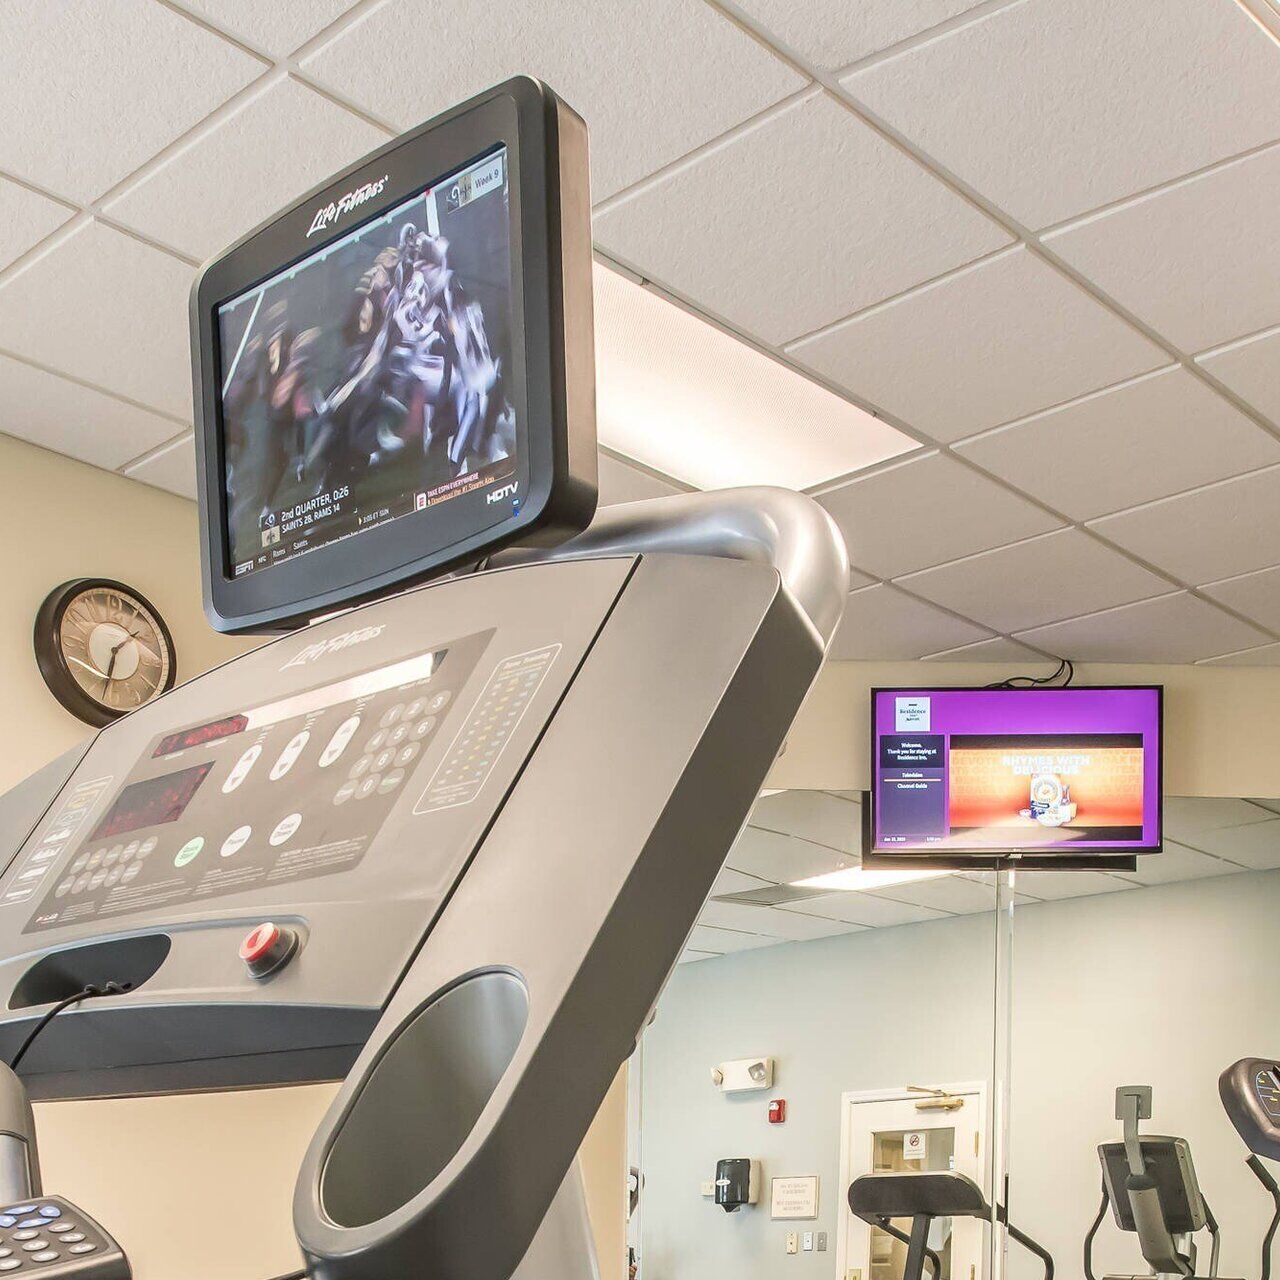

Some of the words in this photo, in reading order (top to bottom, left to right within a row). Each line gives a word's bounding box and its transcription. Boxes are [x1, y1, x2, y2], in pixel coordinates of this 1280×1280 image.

[306, 202, 336, 238] Life
[334, 178, 385, 223] Fitness
[281, 508, 294, 522] 2nd
[295, 494, 332, 517] QUARTER,
[333, 486, 349, 502] 0:26
[487, 481, 518, 504] HDTV
[282, 516, 303, 534] SAINTS
[314, 506, 333, 522] RAMS
[333, 503, 341, 514] 14
[235, 560, 254, 576] ESPN
[1003, 755, 1053, 766] RHYMES
[1056, 755, 1090, 766] WITH
